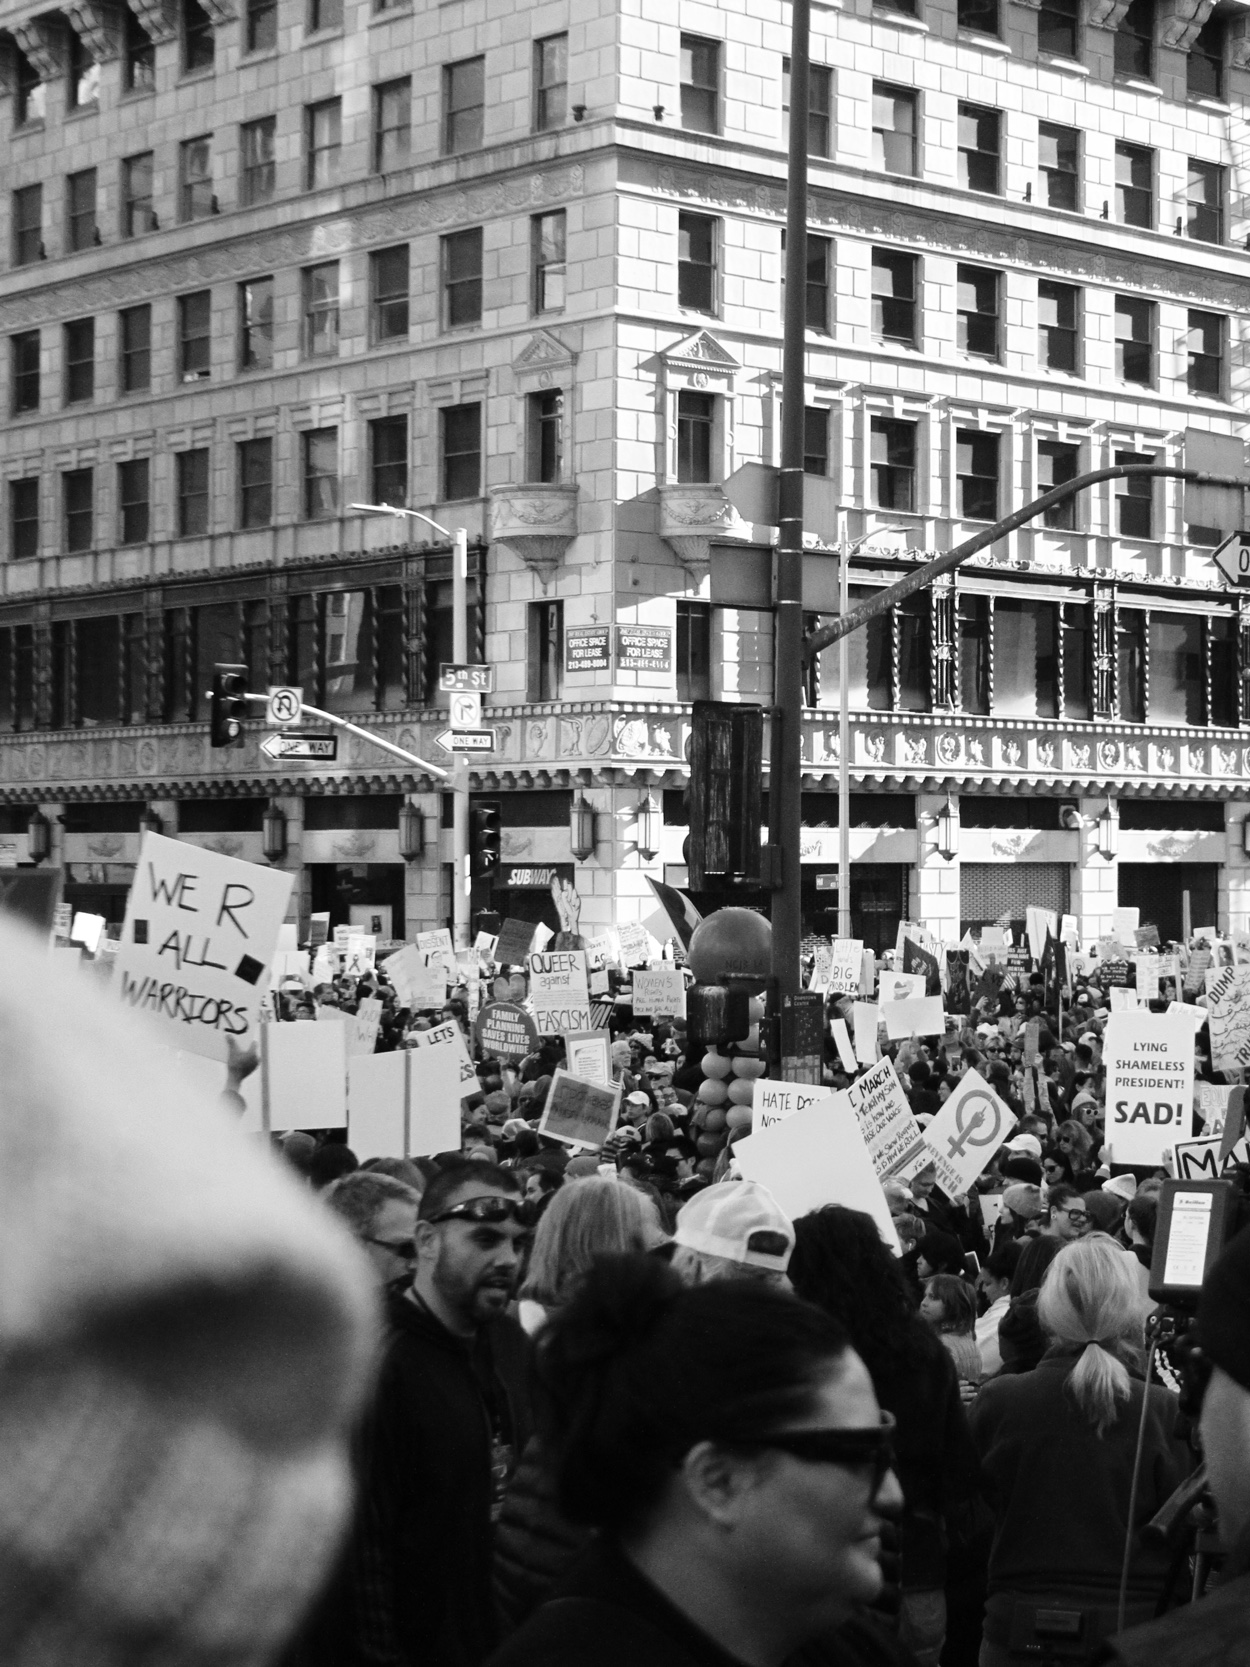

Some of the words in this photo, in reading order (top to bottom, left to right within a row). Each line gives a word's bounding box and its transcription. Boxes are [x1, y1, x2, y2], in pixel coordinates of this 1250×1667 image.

[568, 638, 588, 648] OFFICE
[588, 636, 607, 646] SPACE
[621, 636, 646, 646] OFFICE
[647, 638, 669, 648] SPACE
[572, 649, 584, 658] FOR
[584, 647, 603, 657] LEASE
[626, 647, 641, 657] FOR
[642, 649, 664, 658] LEASE
[445, 668, 468, 685] 5th
[471, 669, 487, 685] St
[279, 740, 300, 754] ONE
[308, 741, 332, 754] WAY
[453, 737, 470, 746] ONE
[472, 737, 489, 746] WAY
[507, 868, 557, 885] SUBWAY
[147, 860, 199, 913] WE
[215, 883, 256, 940] R
[157, 929, 228, 971] ALL
[418, 935, 450, 950] DISSENT
[530, 953, 580, 975] QUEER
[832, 965, 853, 980] BIG
[539, 974, 570, 990] against
[1207, 966, 1236, 1005] DUMP
[121, 970, 249, 1035] WARRIORS
[491, 1009, 520, 1023] FAMILY
[536, 1009, 590, 1033] FASCISM
[486, 1018, 526, 1034] PLANNING
[427, 1026, 455, 1046] LET'S
[481, 1027, 506, 1042] SAVES
[507, 1032, 530, 1045] LIVES
[482, 1038, 529, 1055] WORLDWIDE
[1133, 1042, 1168, 1053] LYING
[1115, 1059, 1185, 1072] SHAMELESS
[858, 1065, 892, 1099] MARCH
[1115, 1077, 1185, 1089] PRESIDENT!
[762, 1091, 792, 1112] HATE
[1114, 1100, 1183, 1126] SAD!
